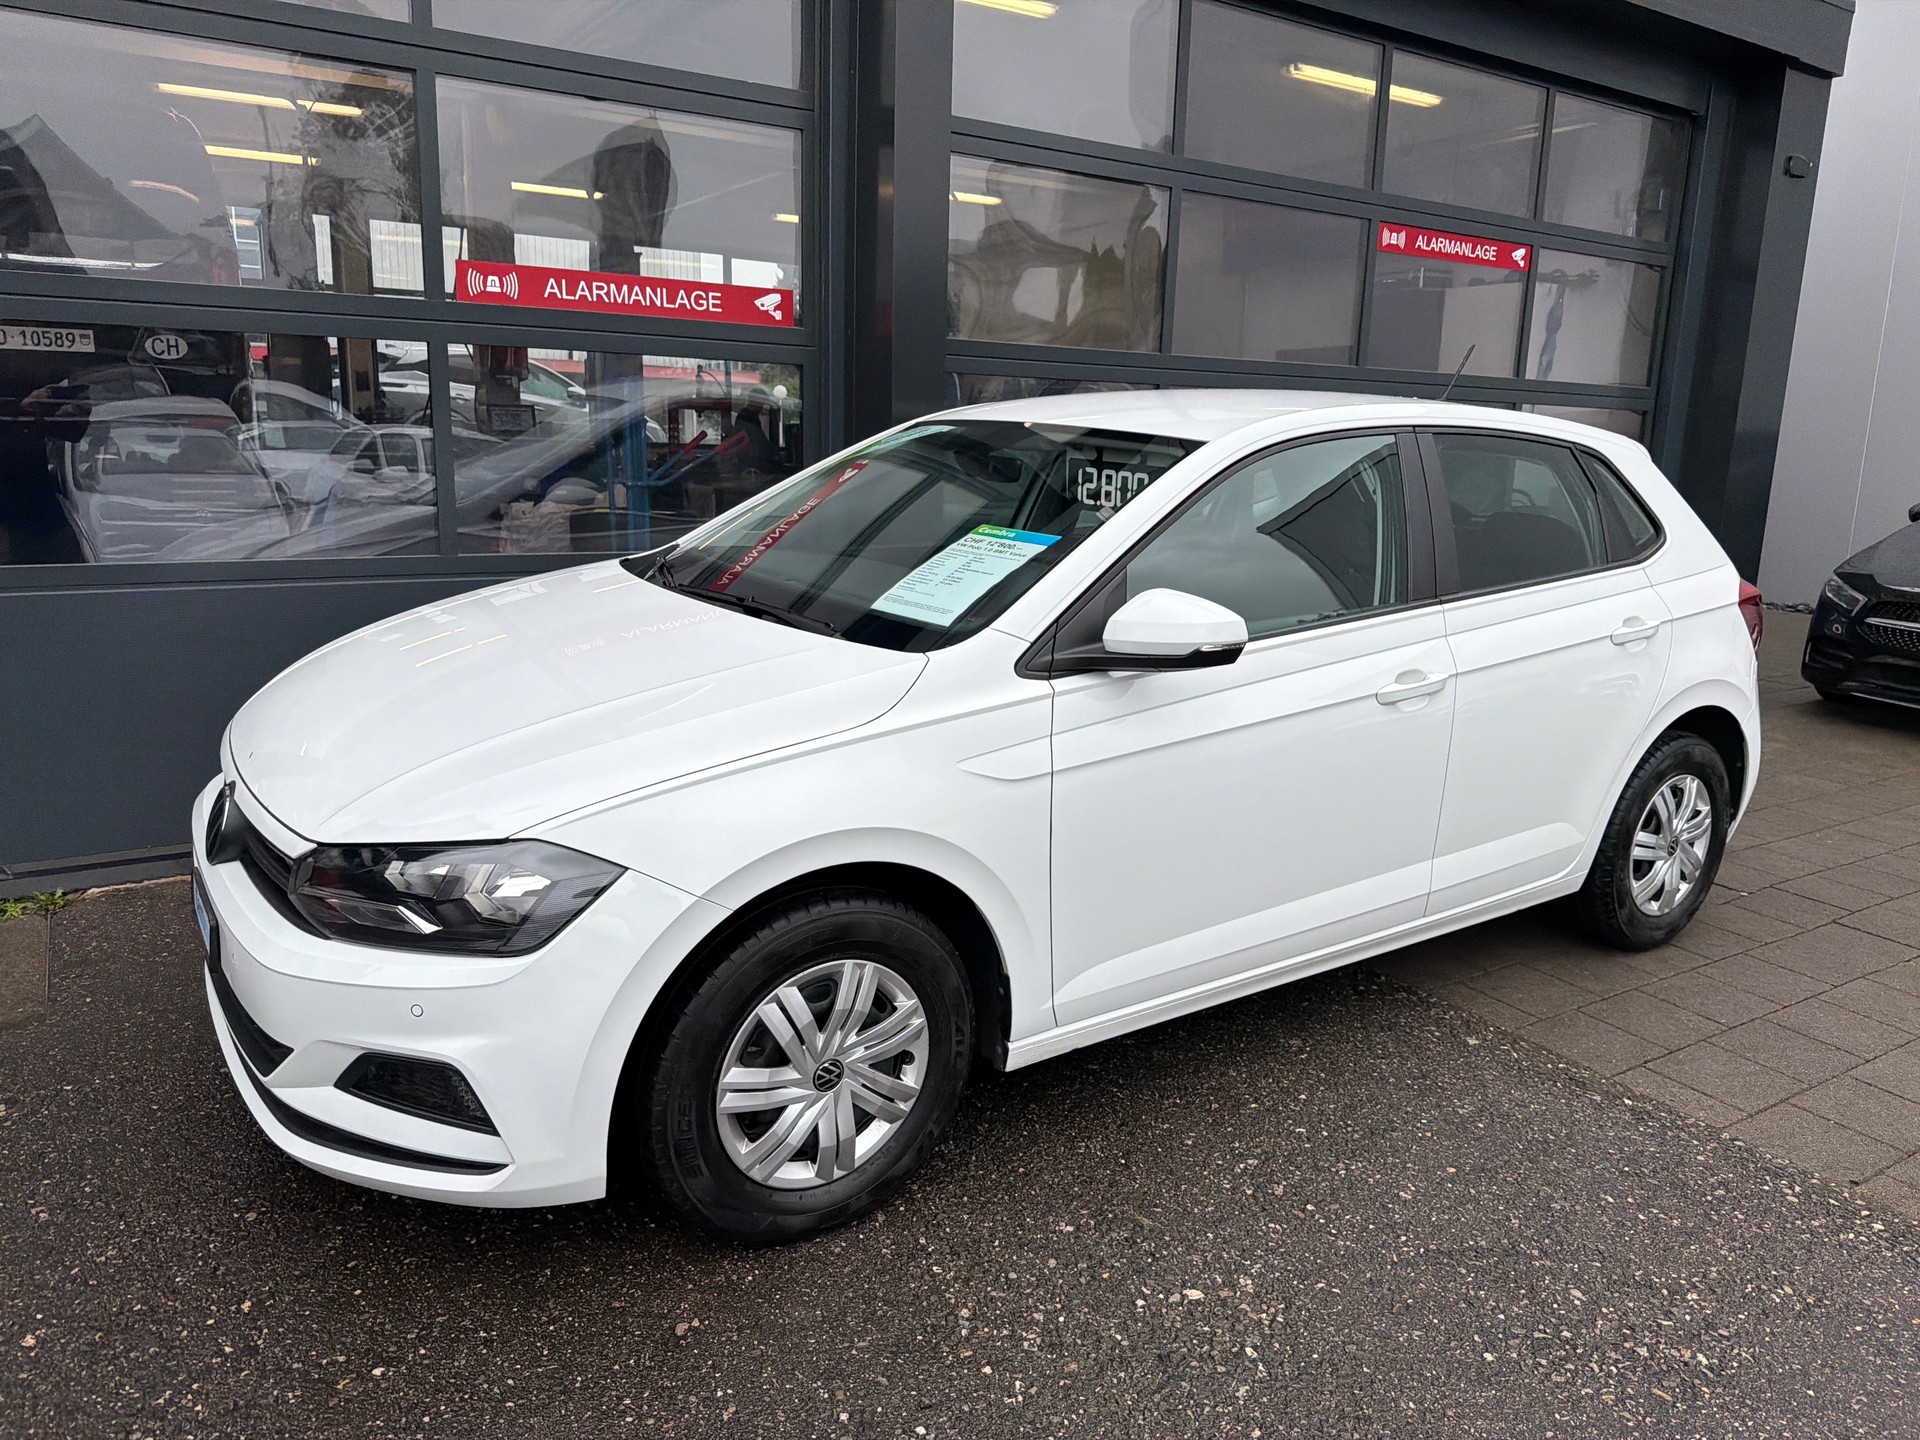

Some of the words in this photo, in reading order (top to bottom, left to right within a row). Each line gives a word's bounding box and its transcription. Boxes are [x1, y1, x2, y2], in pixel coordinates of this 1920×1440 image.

[1415, 234, 1498, 261] ALARMANLAGE
[544, 277, 723, 312] ALARMANLAGE
[151, 337, 180, 356] CH
[978, 527, 1016, 537] Cembra
